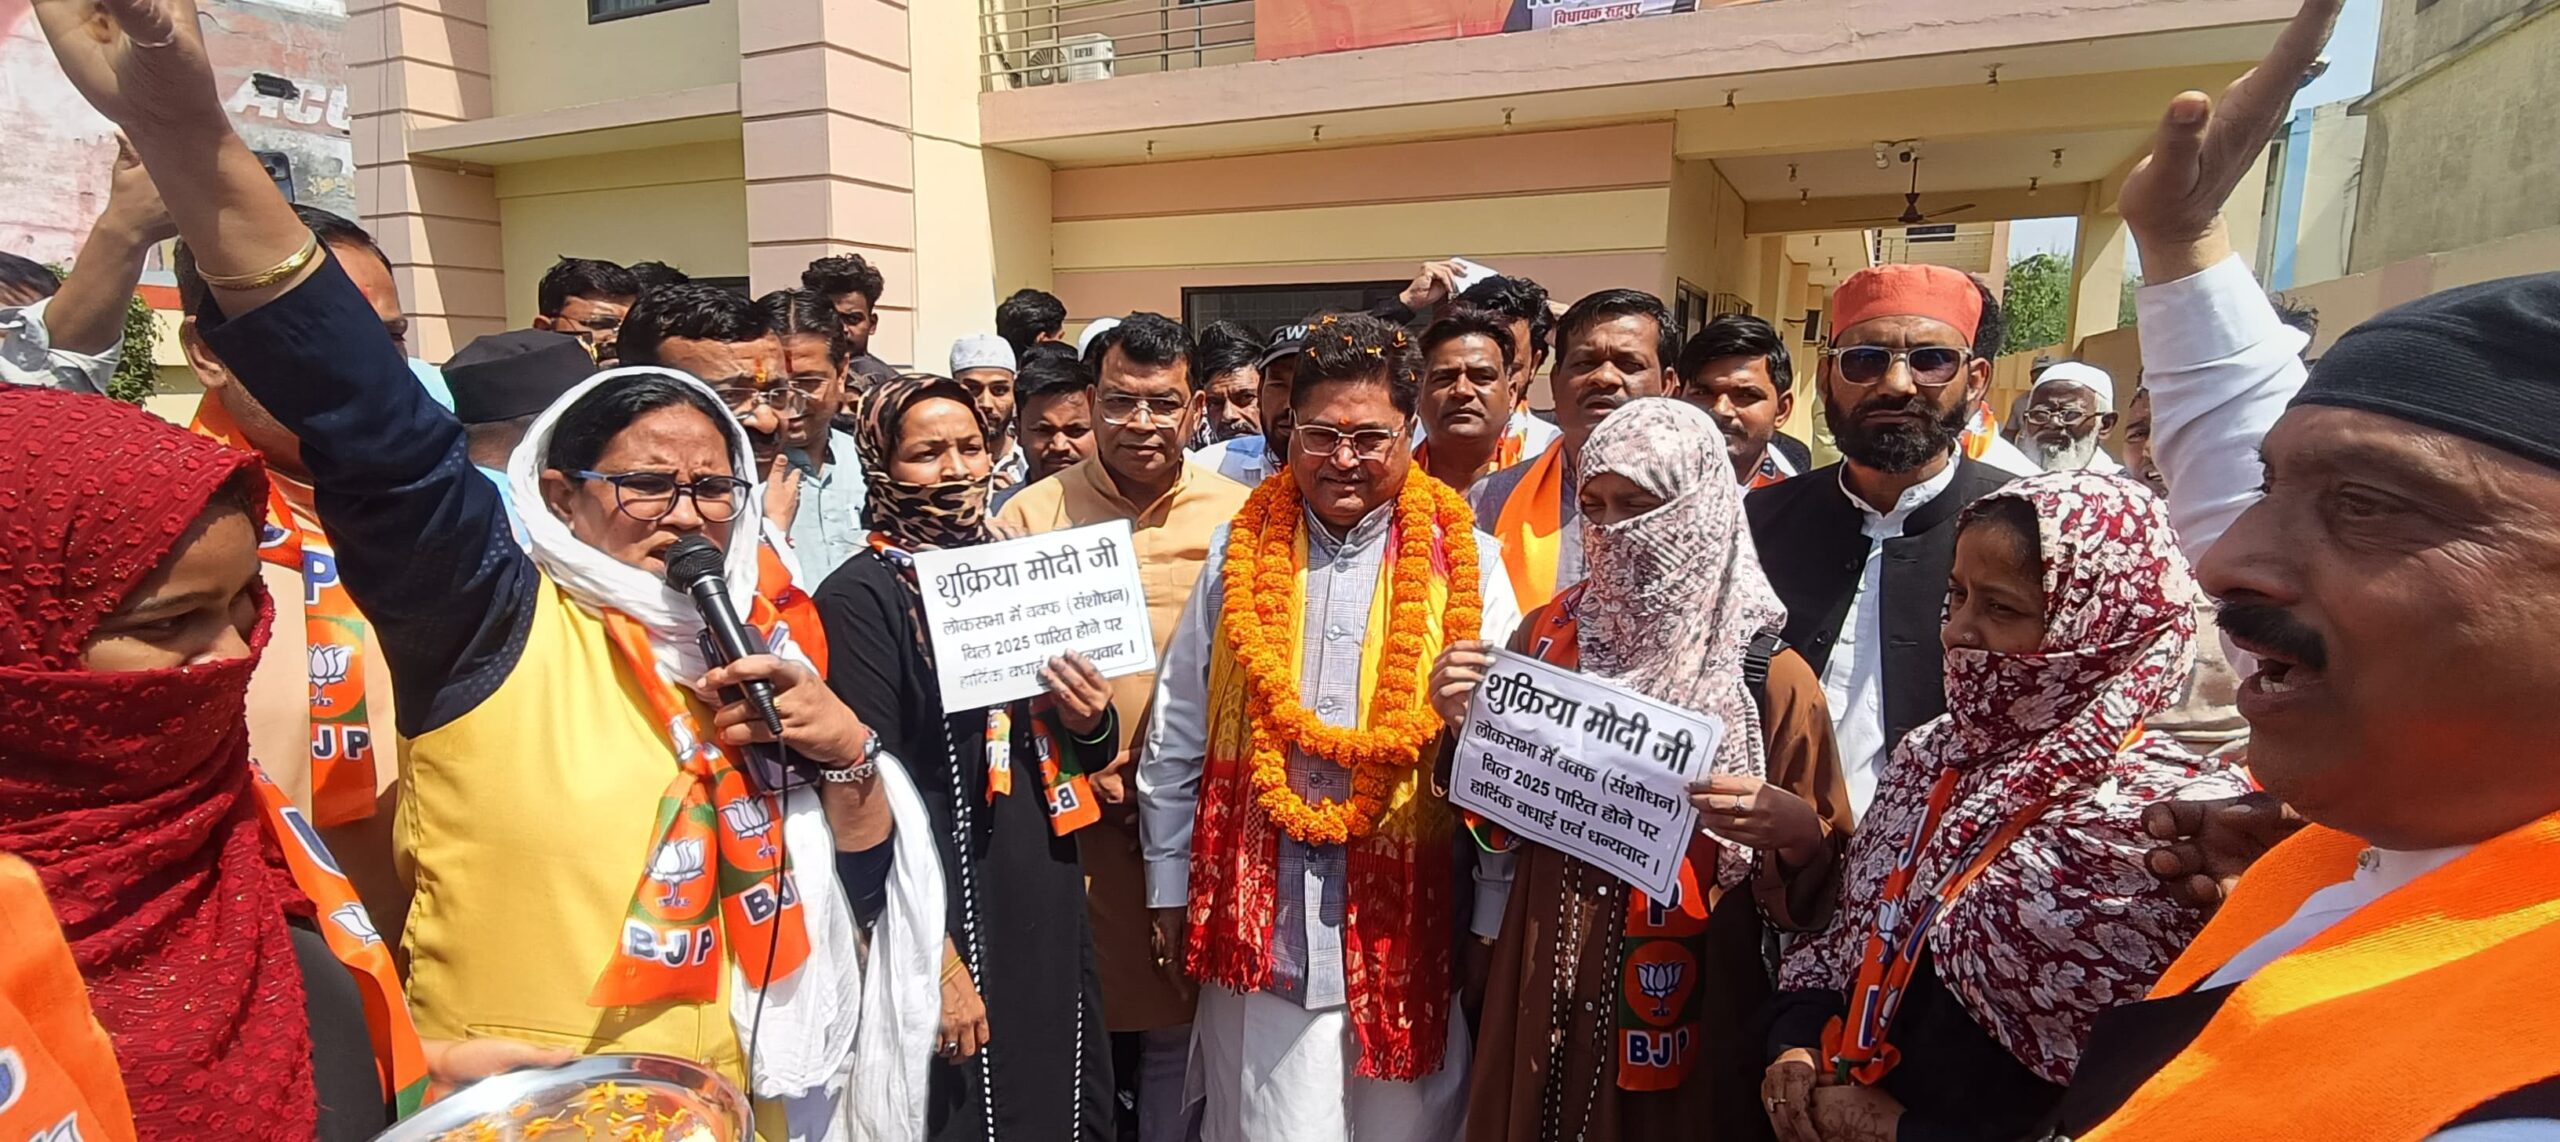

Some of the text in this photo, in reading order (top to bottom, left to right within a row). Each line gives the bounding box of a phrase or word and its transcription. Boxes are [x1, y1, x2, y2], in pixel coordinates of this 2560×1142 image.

[1553, 8, 1601, 25] विधायक
[936, 537, 1119, 608] शुक्रिया मोदी जी
[943, 587, 1130, 636] लोकसभा में वक्फ (संशोधन)
[995, 635, 1031, 656] 2025
[1034, 625, 1073, 647] पारित
[1075, 616, 1101, 639] होने
[1104, 617, 1124, 632] पर
[311, 723, 371, 760] JP
[1485, 672, 1697, 775] शुक्रिया मोदी जी
[1475, 720, 1682, 822] लोकसभा में वक्फ (संशोधन)
[1481, 752, 1661, 843] बिल 2025 पारित होने पर
[1469, 778, 1514, 811] हार्दिक
[1515, 799, 1557, 830] बधाई
[1559, 817, 1587, 840] एवं
[1587, 826, 1651, 870] धन्यवाद
[624, 920, 715, 968] BJP
